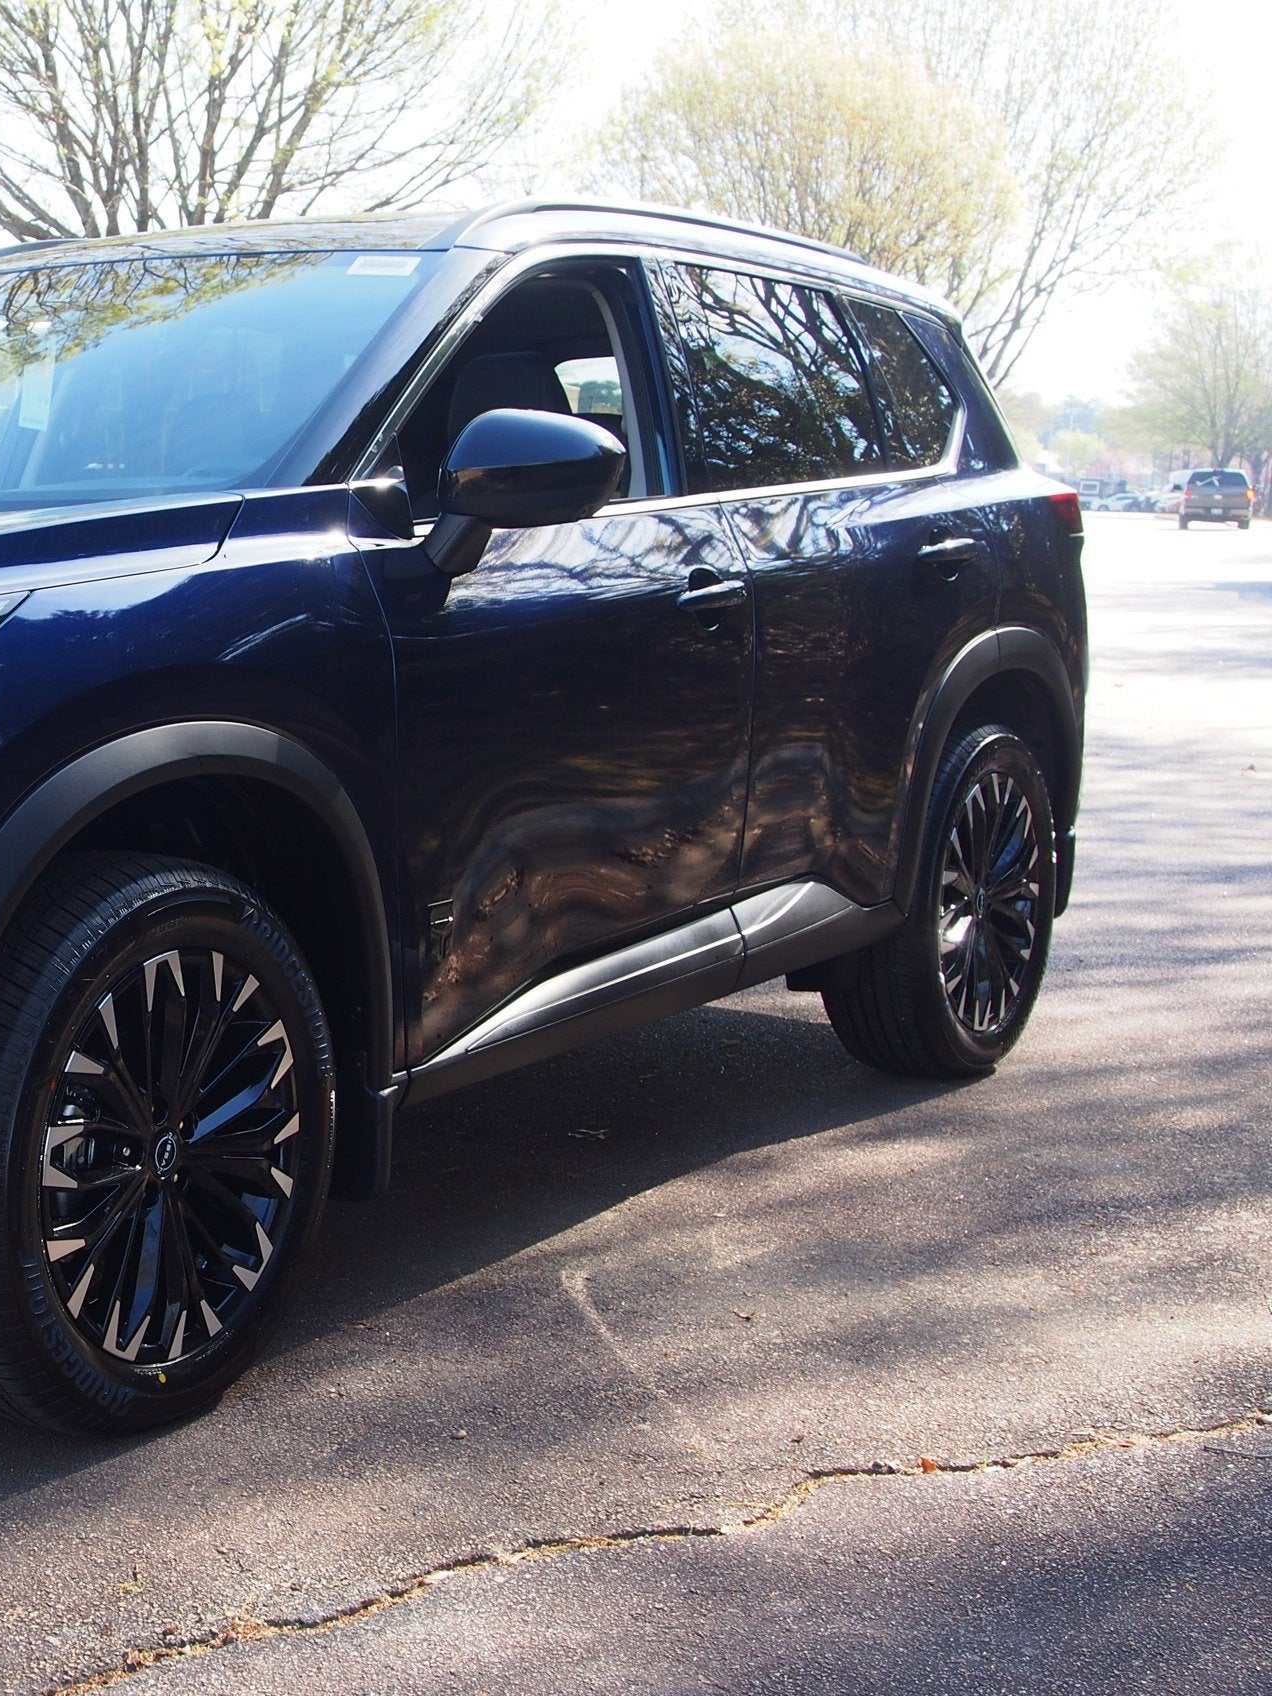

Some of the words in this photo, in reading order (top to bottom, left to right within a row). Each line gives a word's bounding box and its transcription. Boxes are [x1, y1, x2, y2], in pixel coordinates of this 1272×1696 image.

[241, 904, 334, 1078] BRIDGESTONE
[156, 1131, 174, 1175] NISSAN
[19, 1250, 139, 1416] BRIDGESTONE
